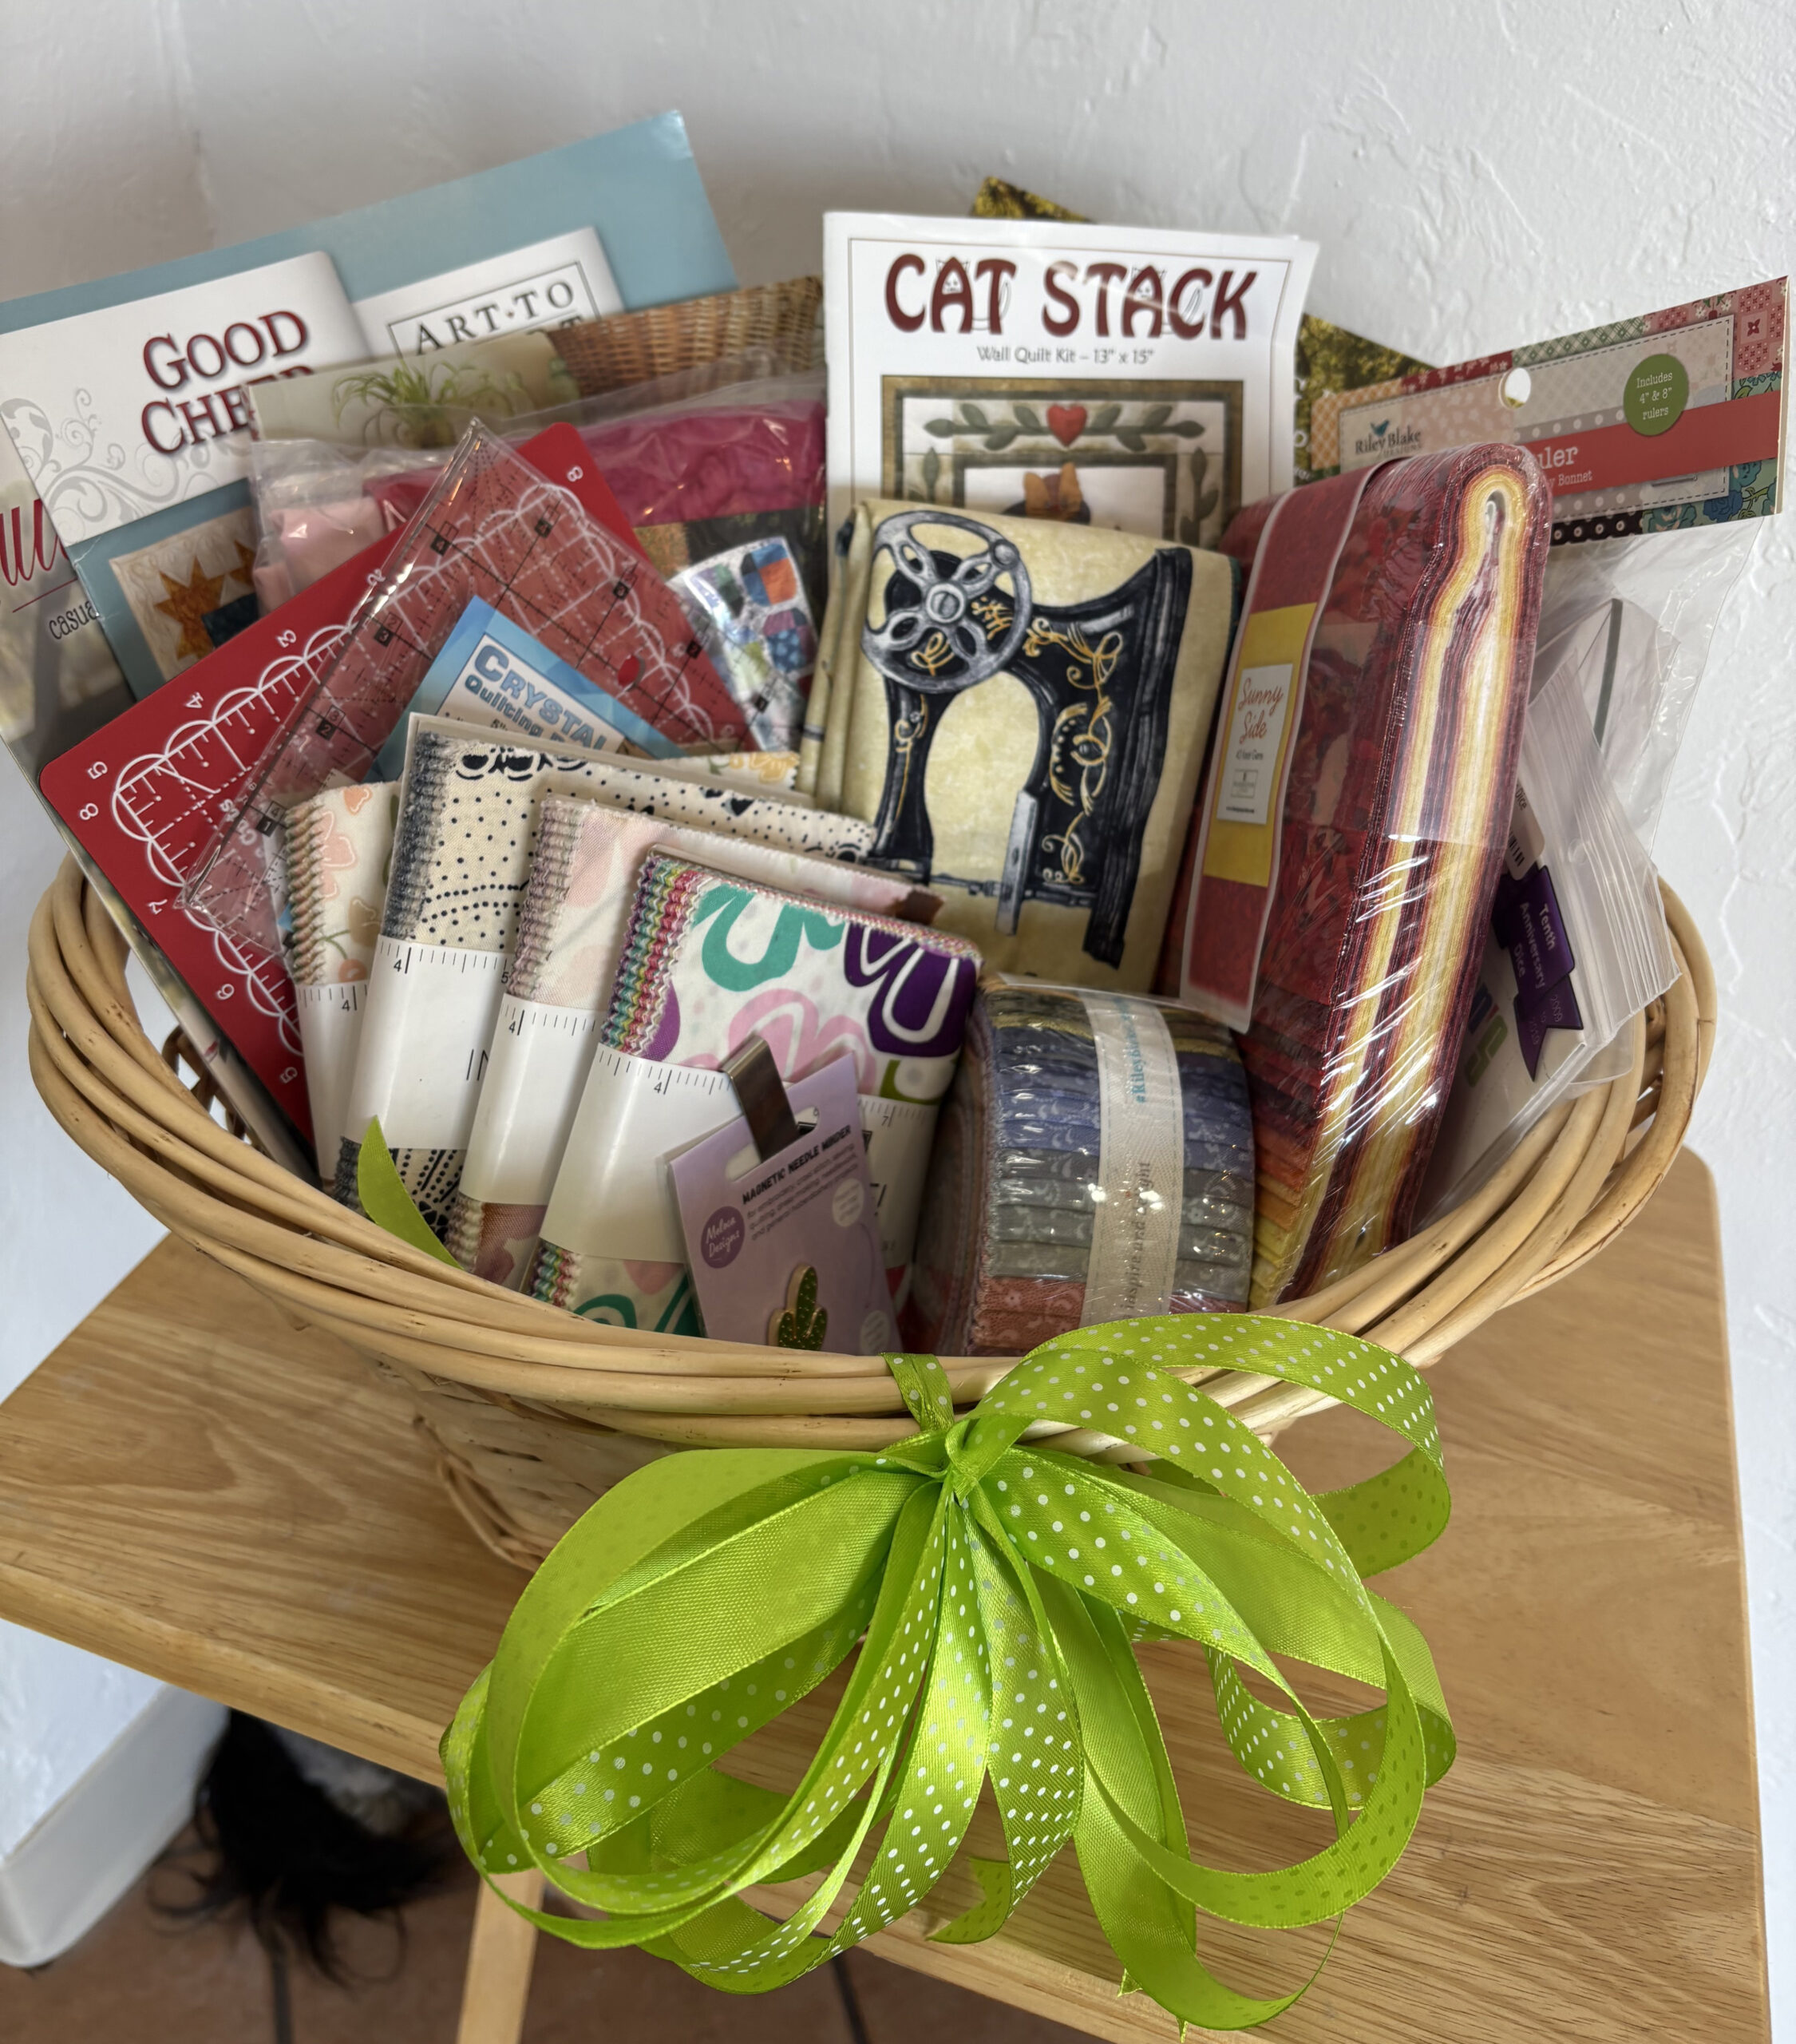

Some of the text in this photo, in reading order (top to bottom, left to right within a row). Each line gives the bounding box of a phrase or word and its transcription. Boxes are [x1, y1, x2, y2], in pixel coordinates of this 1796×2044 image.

[884, 253, 1258, 341] CAT STACK
[144, 311, 308, 390] GOOD
[976, 346, 1011, 362] Wall
[1015, 346, 1051, 364] Quilt
[1056, 348, 1076, 363] Kit
[1118, 354, 1128, 364] x
[1636, 372, 1673, 389] Includes
[1652, 390, 1660, 402] &
[1643, 407, 1669, 420] rulers
[1355, 425, 1422, 455] Riley Blake
[1536, 446, 1580, 470] uler
[1558, 470, 1592, 486] Bonnet
[49, 600, 97, 640] casua
[275, 628, 297, 648] 3
[184, 691, 204, 709] 4
[465, 675, 544, 739] Quilting
[1238, 677, 1284, 716] Sunny
[1240, 710, 1268, 744] Side
[87, 761, 108, 780] 5
[80, 802, 99, 821] 8
[148, 898, 168, 915] 7
[1538, 903, 1555, 951] Tenth
[1519, 901, 1545, 989] Anniversary
[394, 959, 509, 984] 4 5
[1513, 943, 1526, 978] Dice
[342, 1000, 350, 1011] 4
[508, 1020, 516, 1033] 4
[280, 1066, 298, 1084] 5
[654, 1081, 662, 1093] 4
[881, 1115, 889, 1127] 7
[742, 1168, 786, 1205] MAGNETIC
[788, 1145, 820, 1175] NEEDLE
[821, 1124, 851, 1151] MINDER
[709, 1230, 740, 1258] Designs
[1120, 1256, 1143, 1309] inspire
